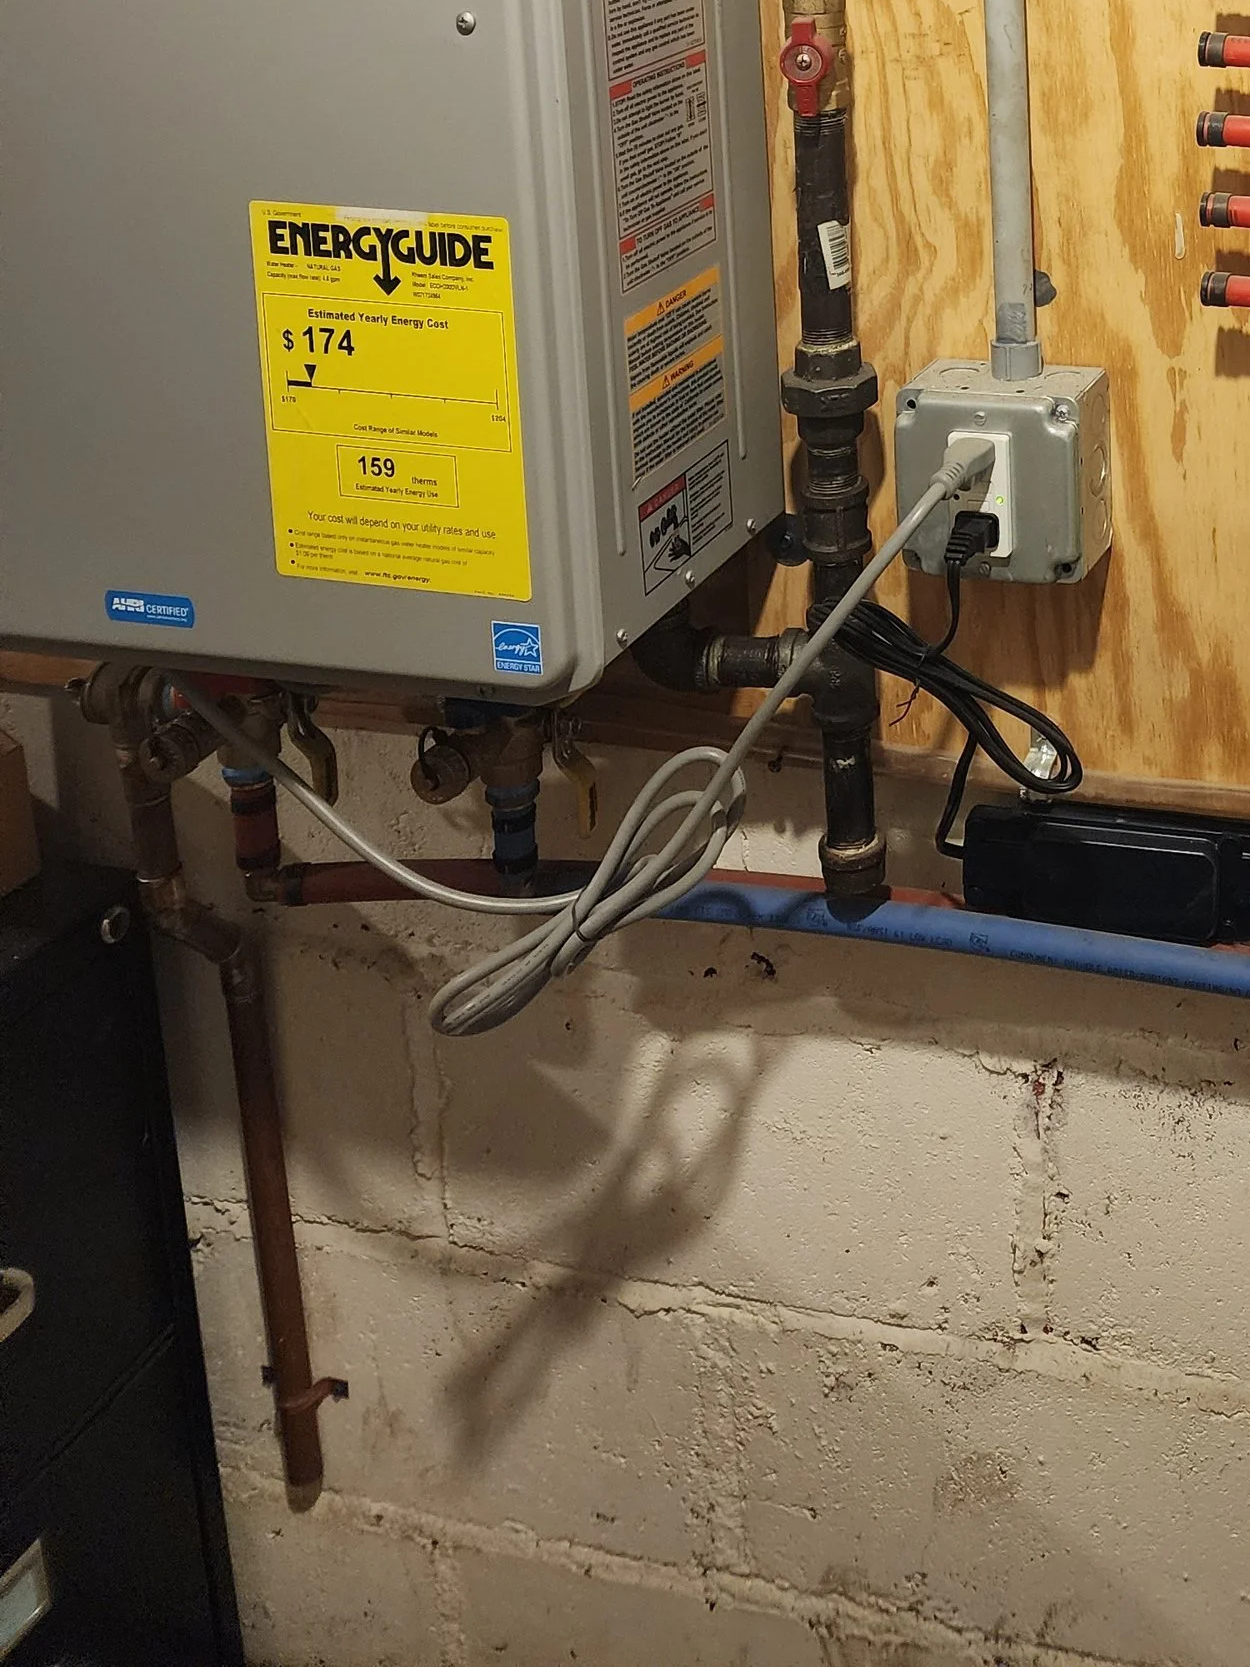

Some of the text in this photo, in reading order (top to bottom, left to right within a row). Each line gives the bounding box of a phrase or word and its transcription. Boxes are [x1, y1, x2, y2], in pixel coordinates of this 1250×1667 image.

[268, 220, 495, 270] ENERGYGUIDE
[665, 289, 687, 309] DANGER
[308, 309, 448, 329] Estimated Yearly Energy Cost
[282, 326, 355, 356] $ 174
[670, 360, 694, 380] WARNING
[368, 425, 387, 434] Range
[396, 427, 416, 436] Similar
[417, 429, 438, 438] Models
[358, 455, 395, 478] 159
[356, 483, 438, 498] Estimated Yearly Energy Use
[411, 476, 437, 486] therms
[307, 510, 496, 539] Your cost will depend on your utility rates and use
[497, 662, 539, 672] ENERGY STAR
